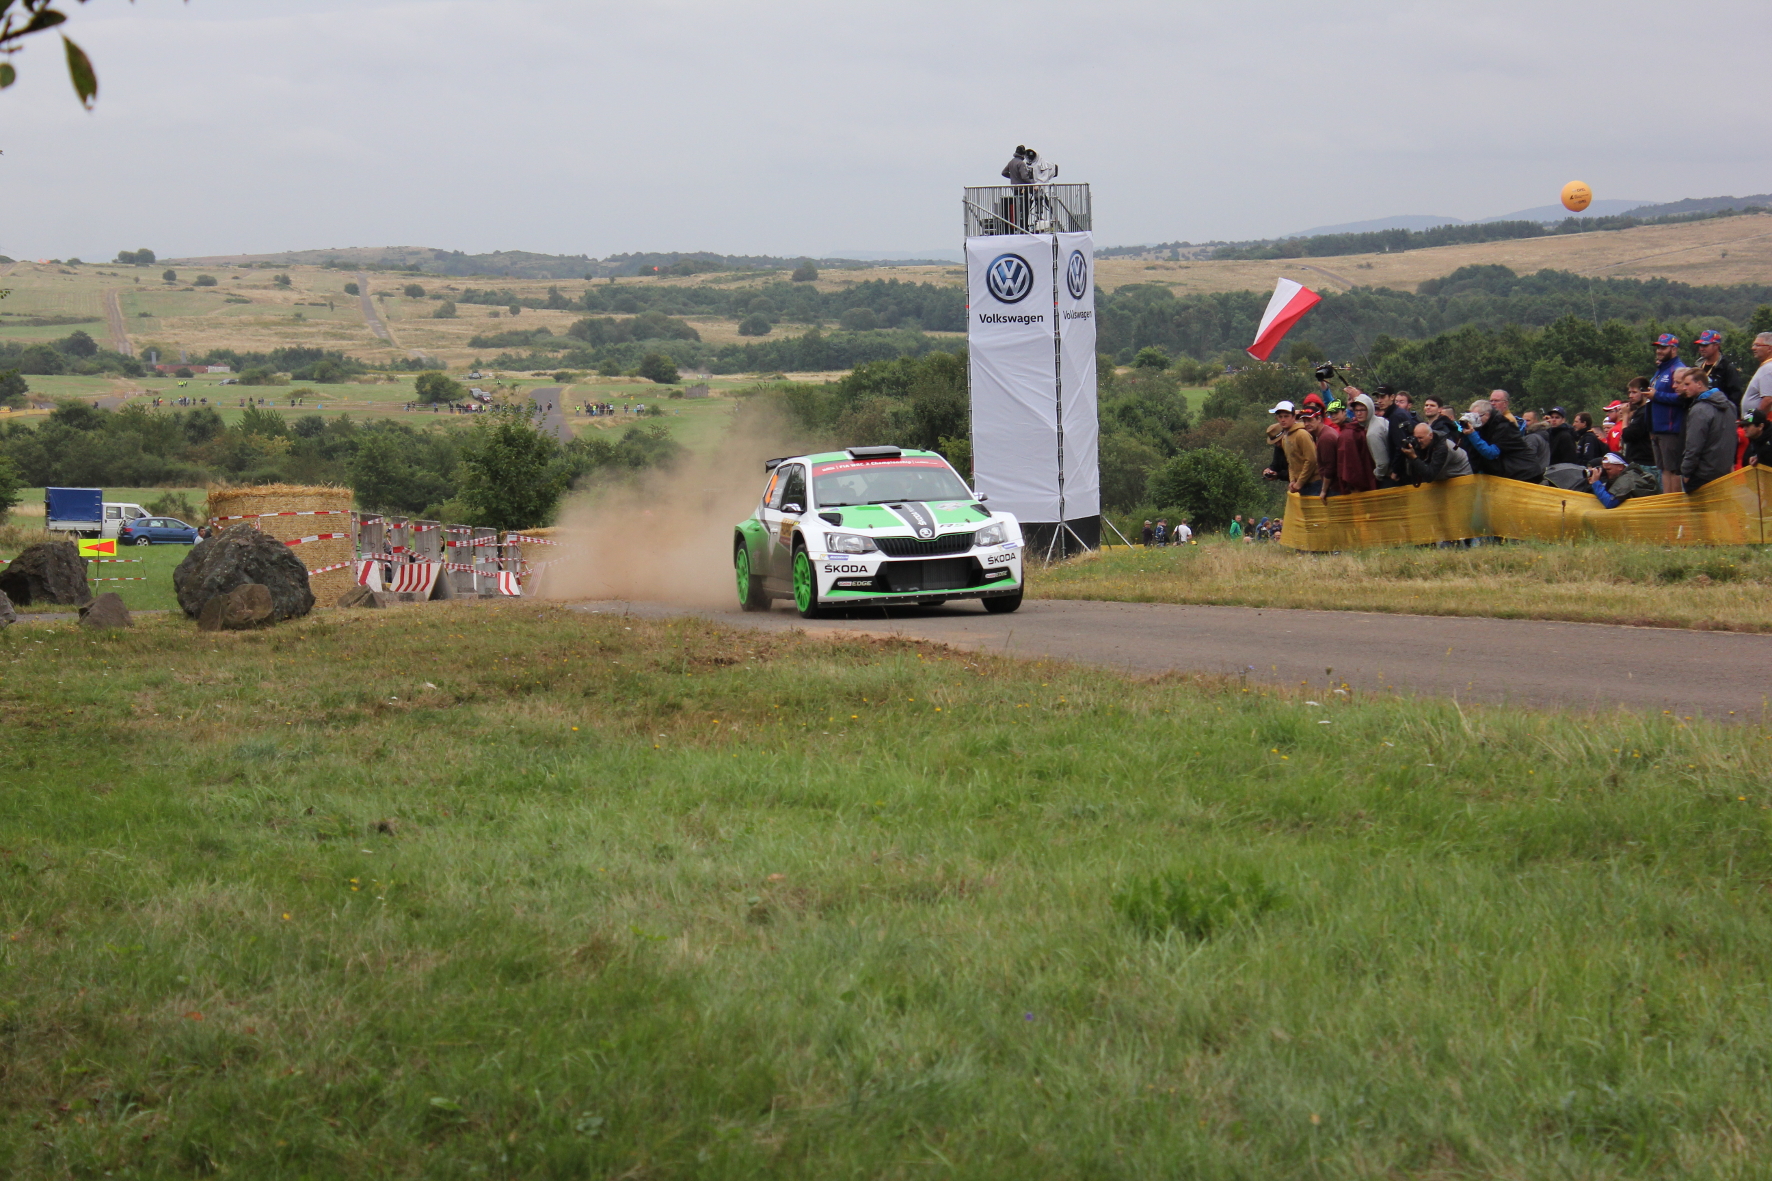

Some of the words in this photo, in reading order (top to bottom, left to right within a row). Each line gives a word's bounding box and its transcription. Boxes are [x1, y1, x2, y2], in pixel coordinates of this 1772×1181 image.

[979, 313, 1044, 325] Volkswagen
[1063, 310, 1092, 321] Volkswagen
[988, 552, 1016, 565] ŠKODA
[825, 563, 868, 573] ŠKODA
